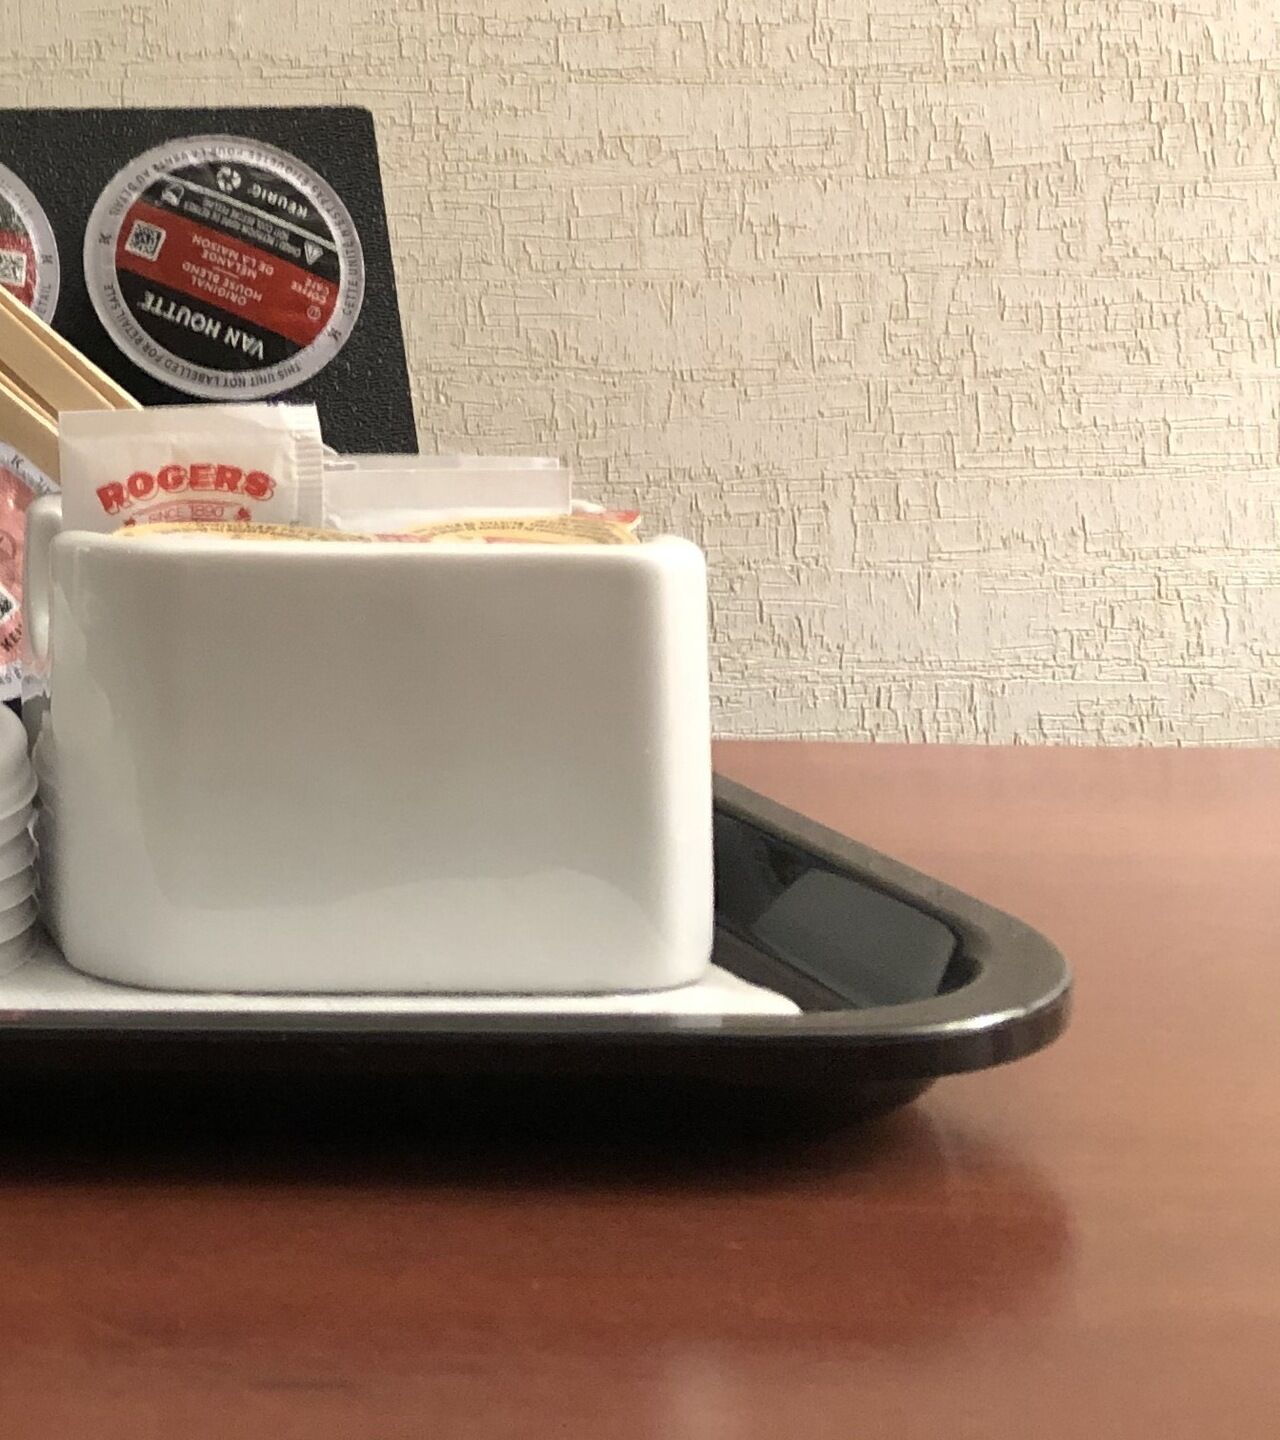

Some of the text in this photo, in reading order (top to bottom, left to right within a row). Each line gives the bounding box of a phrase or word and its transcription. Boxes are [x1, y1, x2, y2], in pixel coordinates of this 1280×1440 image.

[252, 183, 307, 219] KEURIG
[191, 234, 240, 260] MAISON
[182, 262, 263, 302] HOUSE BLEND
[191, 276, 247, 306] ORIGINAL
[103, 283, 215, 388] LABELLED FOR RETAIL SALE
[140, 290, 265, 360] VAN HOUTTE
[96, 462, 275, 516] ROGERS
